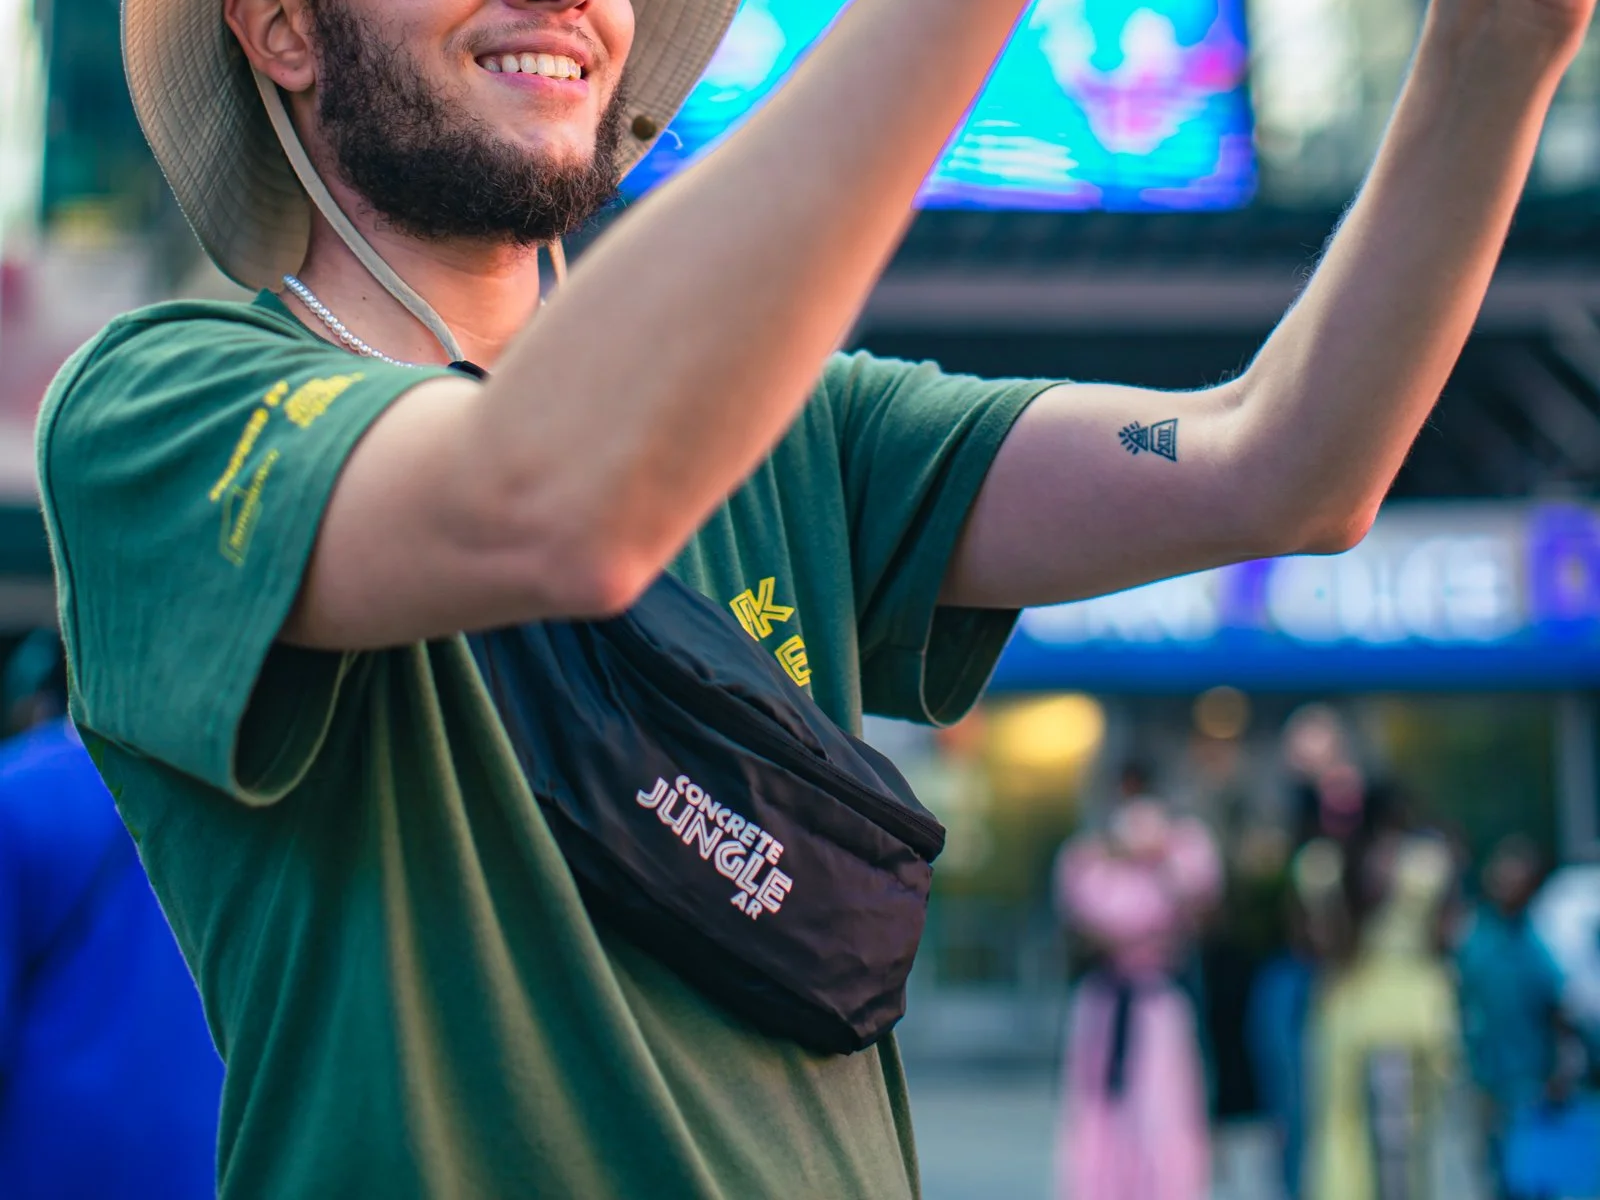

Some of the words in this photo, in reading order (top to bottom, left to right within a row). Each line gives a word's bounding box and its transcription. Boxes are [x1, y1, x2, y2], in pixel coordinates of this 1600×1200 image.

[636, 776, 794, 915] JUNGLE
[675, 774, 785, 866] CONCRETE
[730, 890, 763, 921] AR
